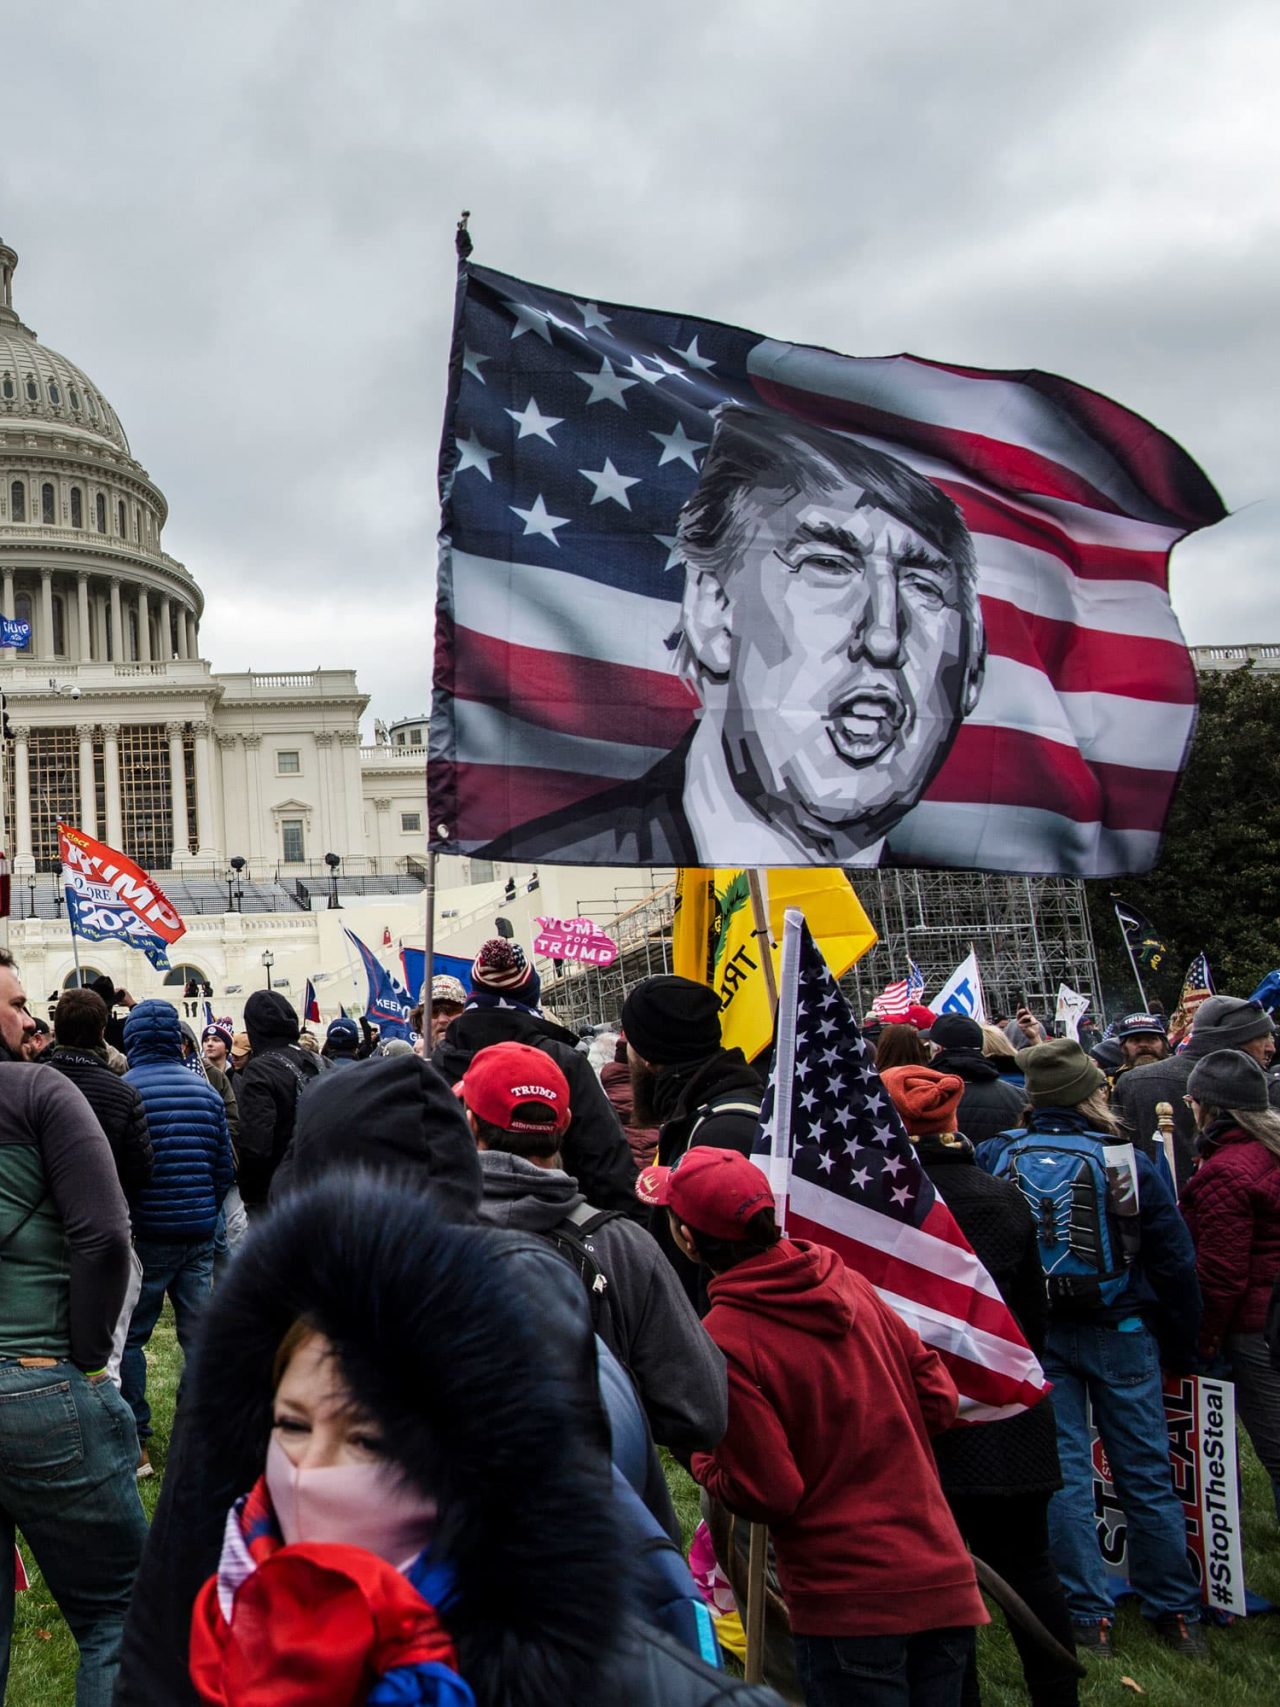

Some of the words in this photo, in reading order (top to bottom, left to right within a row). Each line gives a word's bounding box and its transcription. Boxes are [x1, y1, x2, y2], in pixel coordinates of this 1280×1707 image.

[541, 916, 605, 938] WOME
[566, 935, 589, 944] FOR
[538, 939, 612, 962] TRUMP
[1124, 1016, 1156, 1025] TRUMP
[511, 1085, 557, 1100] TRUMP
[1202, 1383, 1233, 1605] #StopTheSteal
